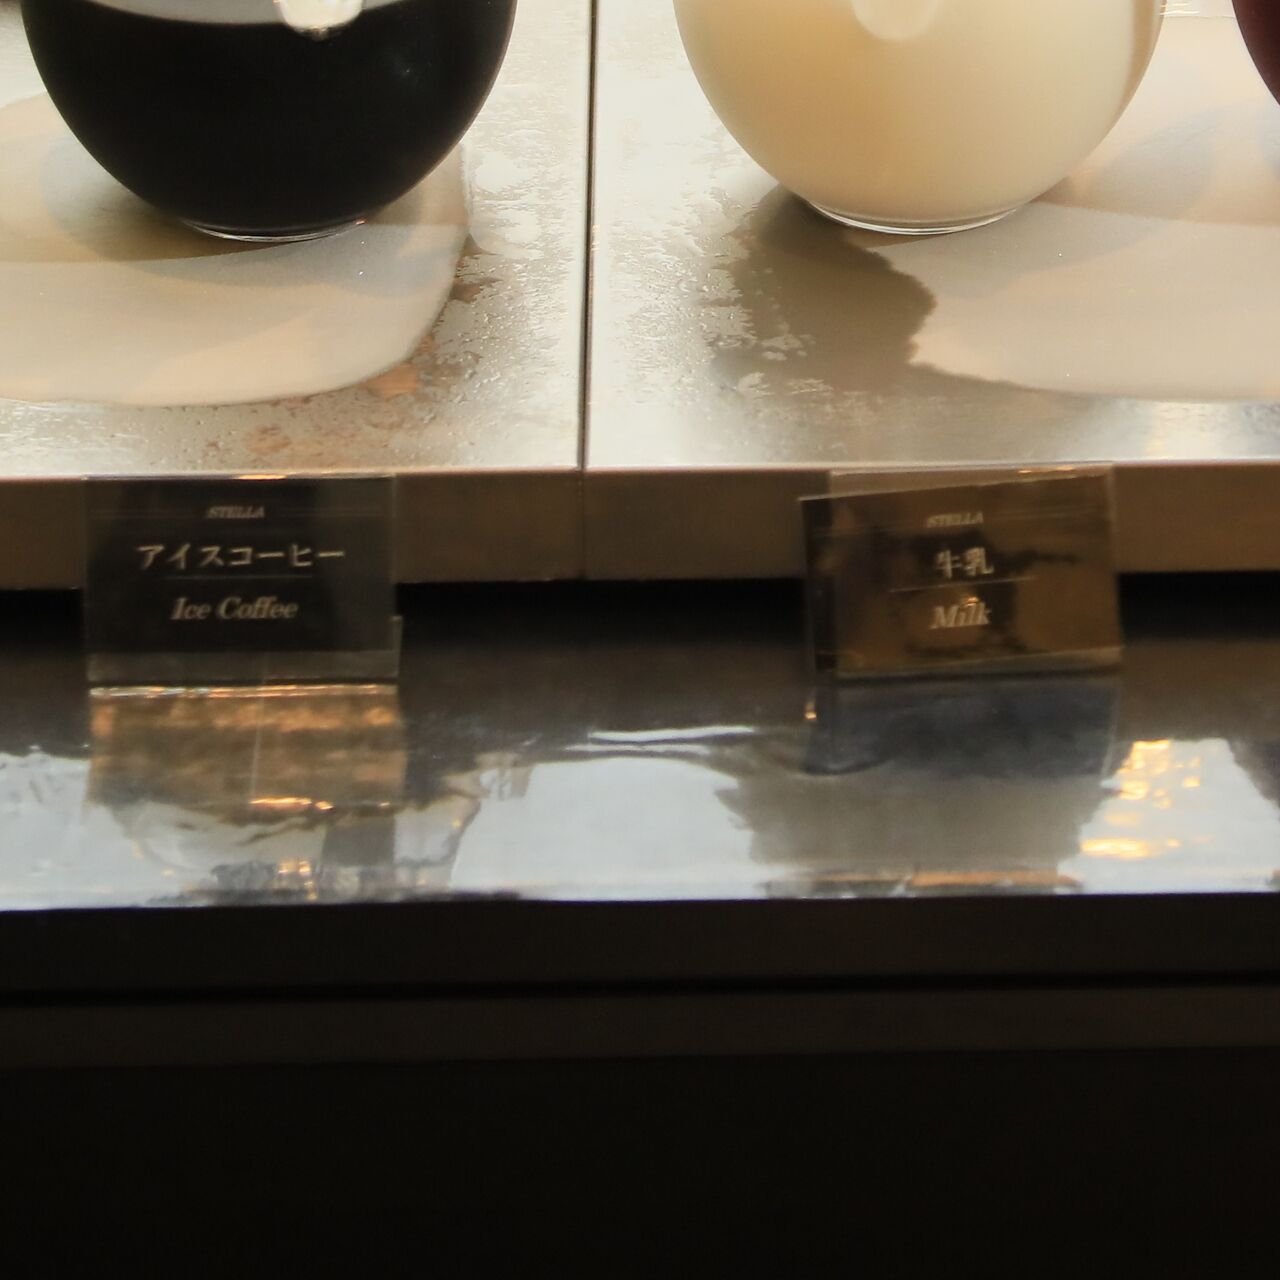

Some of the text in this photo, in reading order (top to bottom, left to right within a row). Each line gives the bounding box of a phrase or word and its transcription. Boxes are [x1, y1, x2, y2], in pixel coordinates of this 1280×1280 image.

[205, 505, 266, 520] STELLA
[135, 542, 346, 572] アイスコーヒー
[934, 546, 995, 581] 牛乳
[170, 595, 299, 622] Ice Coffee
[929, 602, 993, 630] Milk
